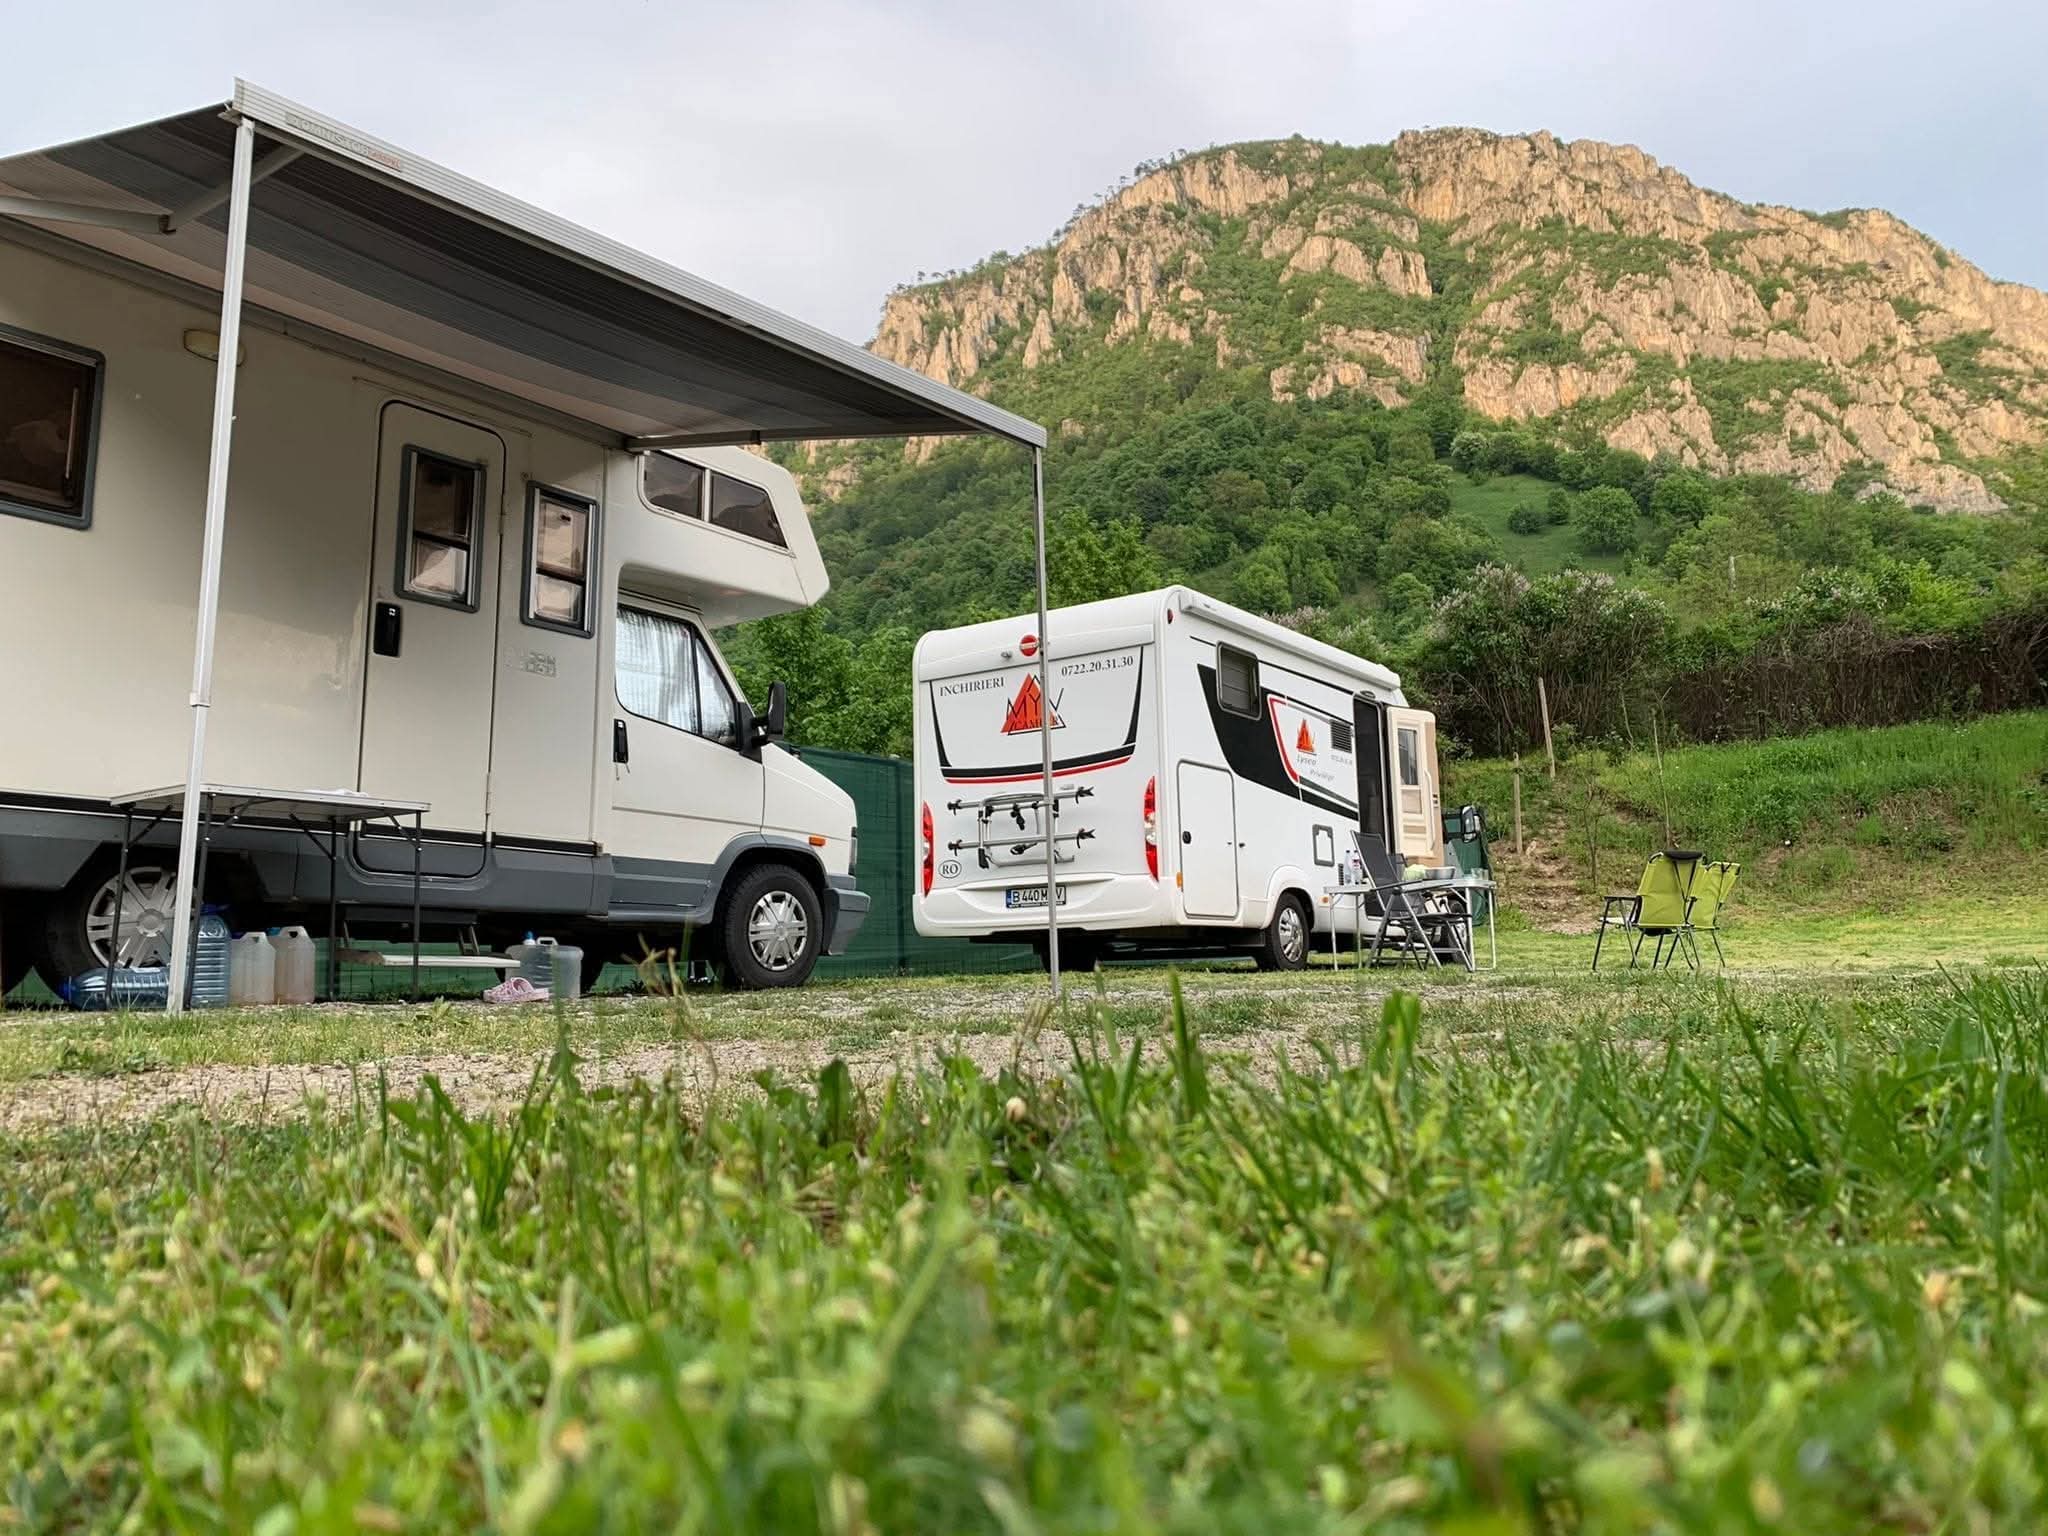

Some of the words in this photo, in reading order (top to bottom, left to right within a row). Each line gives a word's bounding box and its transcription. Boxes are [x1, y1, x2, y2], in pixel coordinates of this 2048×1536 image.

[1060, 655, 1134, 677] 0722.20.31.30
[940, 677, 1004, 696] INCHIRIERI
[942, 864, 958, 875] RO
[1012, 891, 1020, 903] B
[1040, 887, 1063, 900] MV
